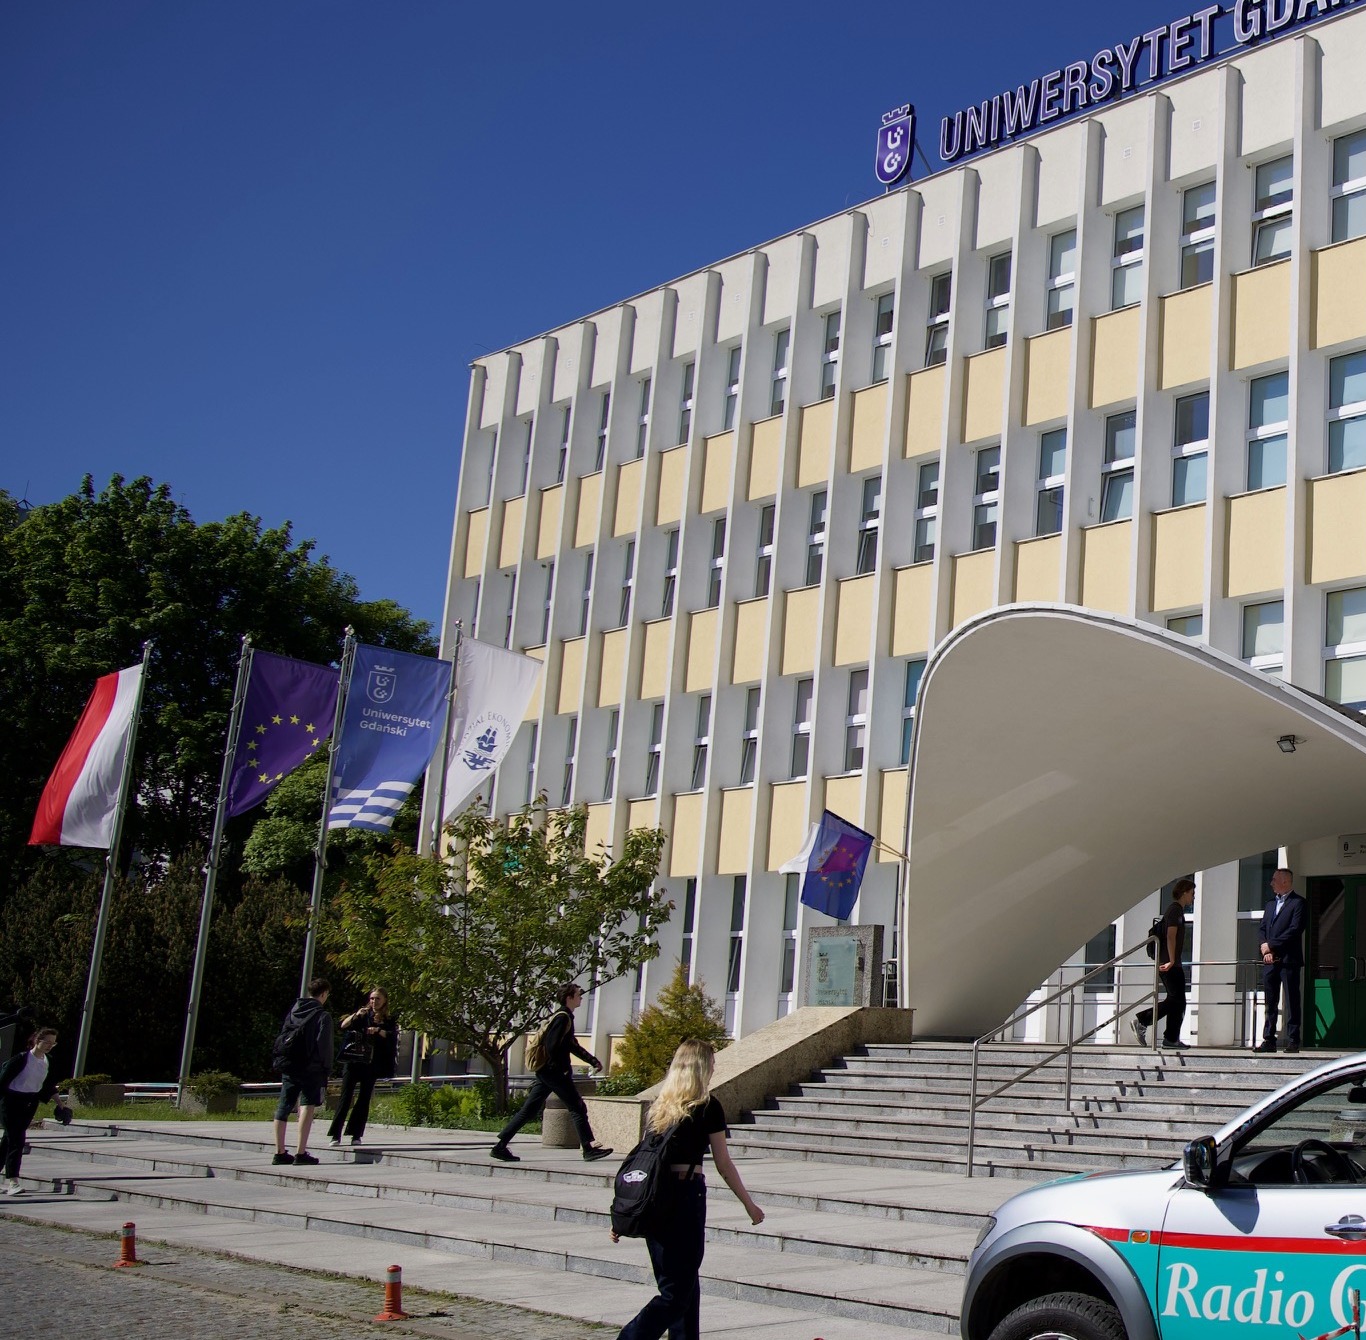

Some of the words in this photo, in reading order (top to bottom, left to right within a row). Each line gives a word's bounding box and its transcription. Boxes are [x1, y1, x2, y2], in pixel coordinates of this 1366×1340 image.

[939, 3, 1222, 162] UNIWERSYTET
[359, 719, 408, 737] Gdański
[362, 707, 432, 729] Uniwersytet
[1160, 1262, 1315, 1328] Radio
